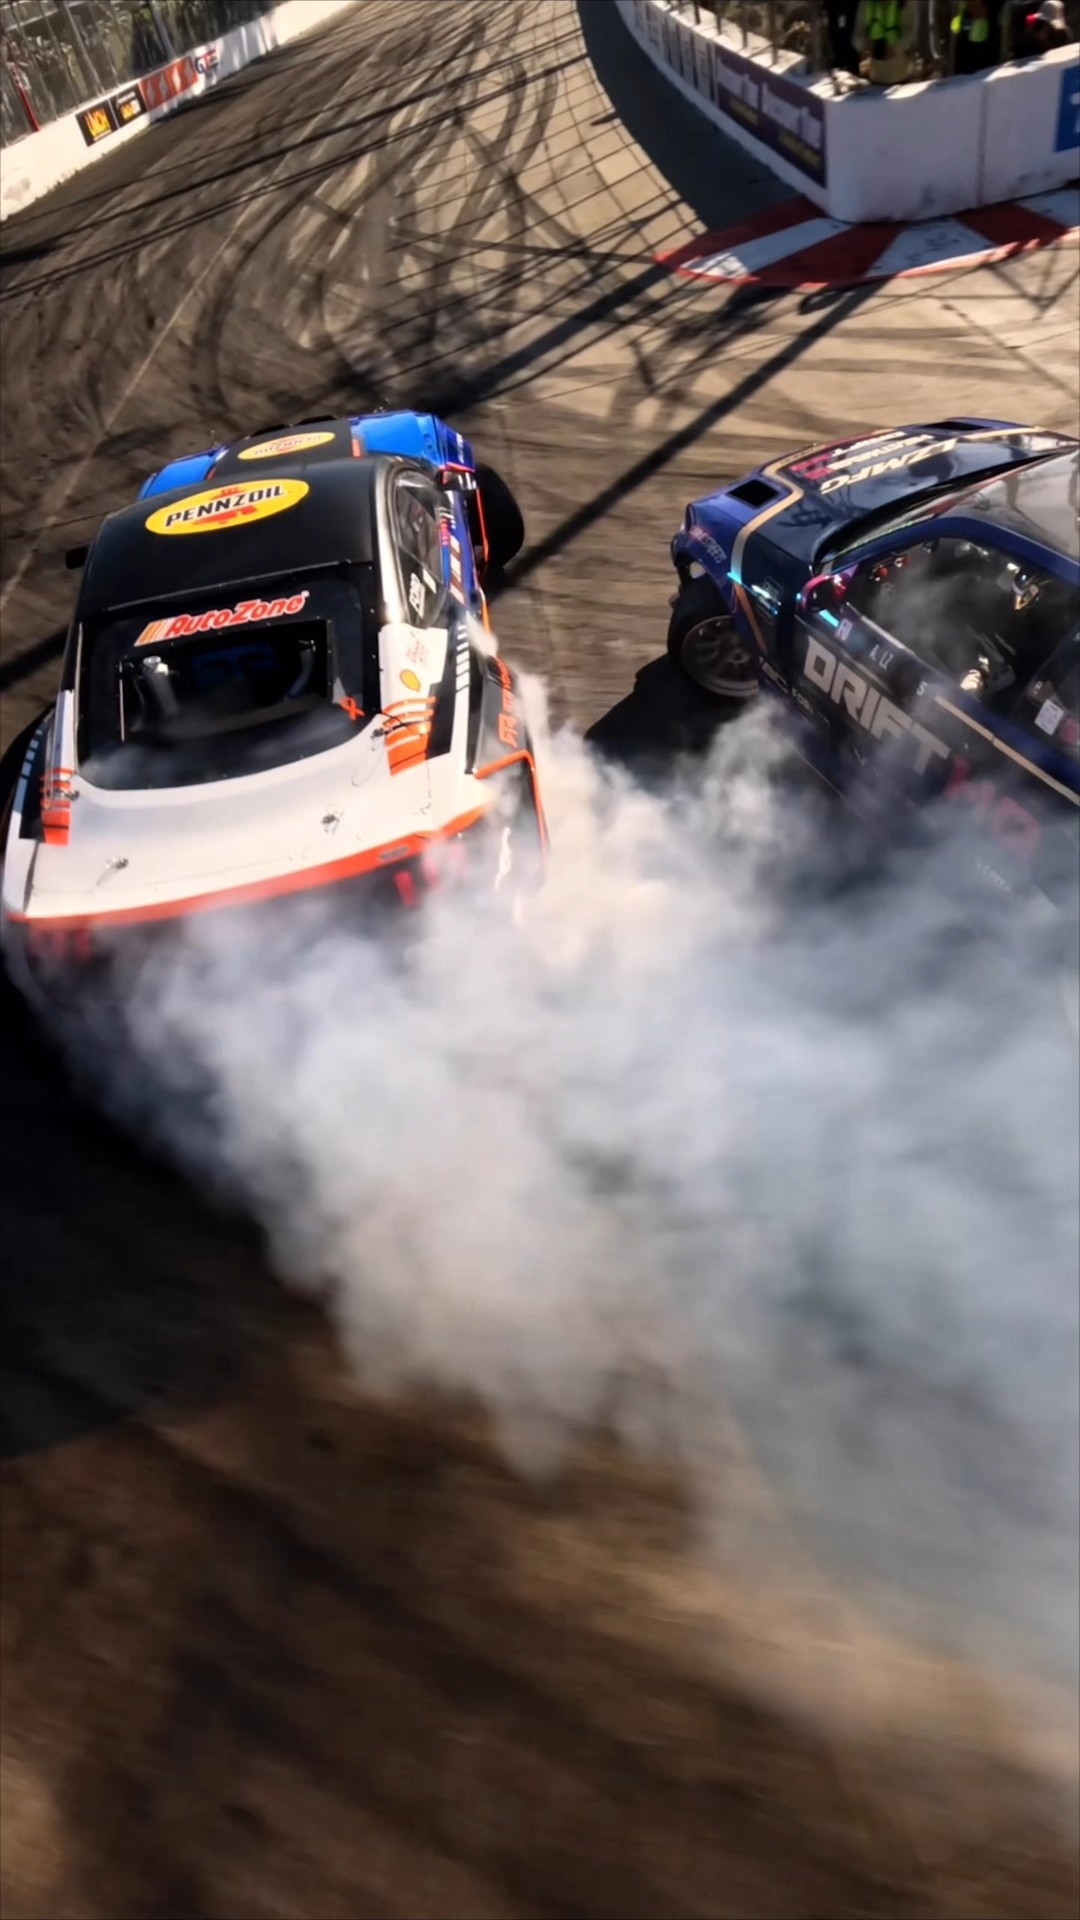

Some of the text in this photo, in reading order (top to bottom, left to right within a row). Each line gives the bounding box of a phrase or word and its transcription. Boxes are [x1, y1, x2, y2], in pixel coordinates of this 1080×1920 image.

[165, 486, 284, 527] PENNZOIL
[164, 594, 306, 639] AutoZone
[803, 635, 952, 776] DRIFT
